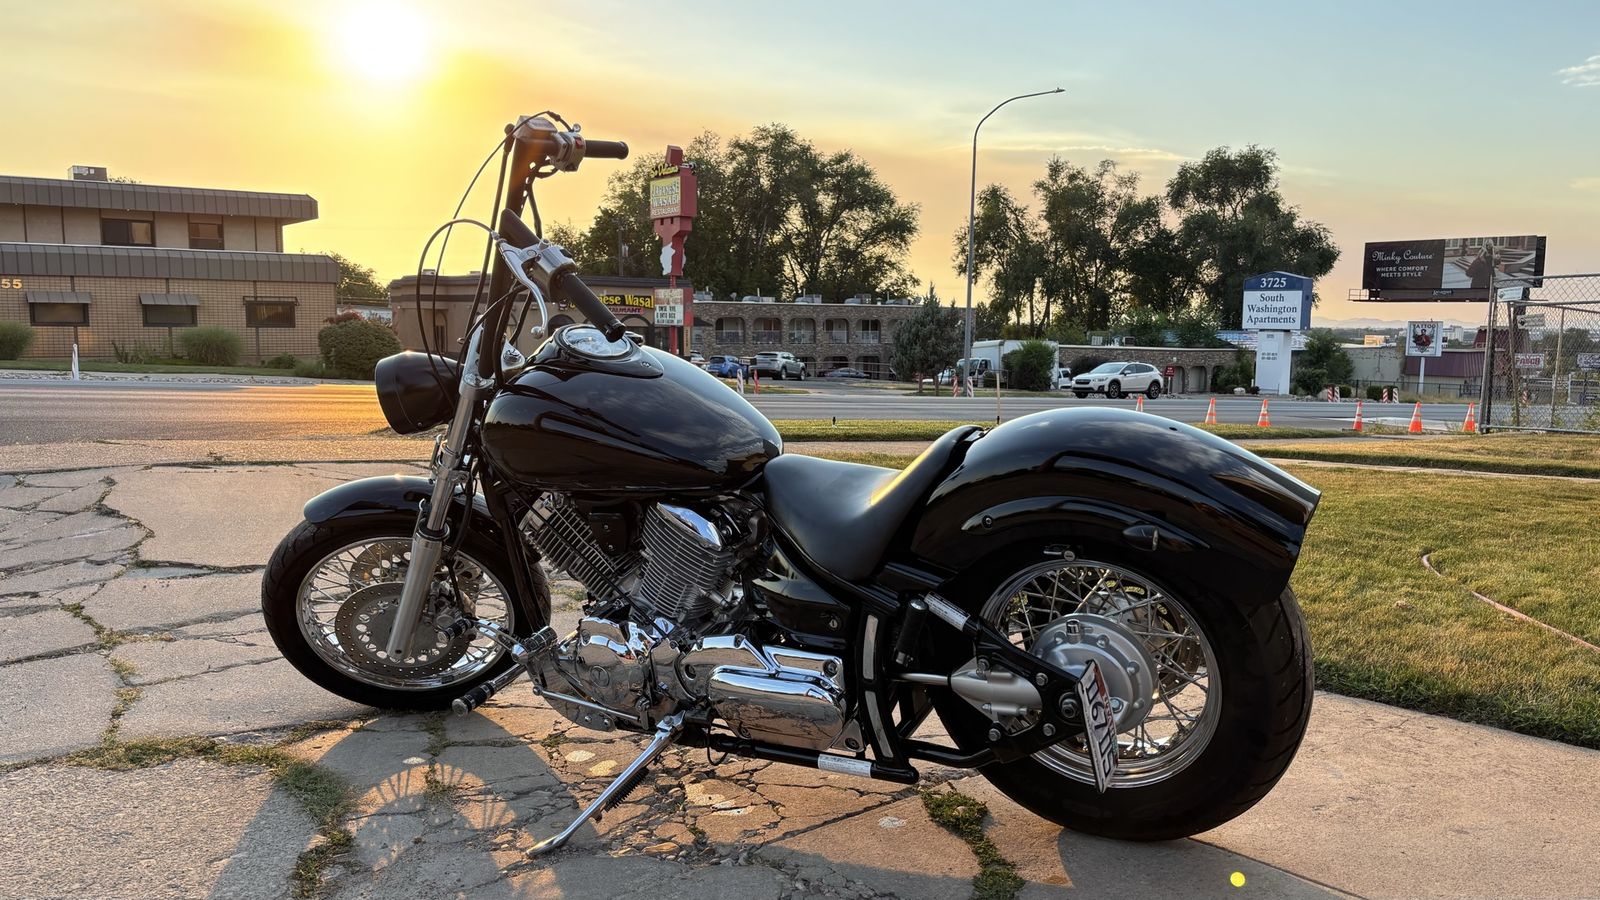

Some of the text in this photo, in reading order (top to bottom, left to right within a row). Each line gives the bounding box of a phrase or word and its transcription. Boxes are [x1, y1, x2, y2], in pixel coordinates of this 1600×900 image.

[1372, 250, 1402, 264] Minky
[1260, 277, 1287, 288] 3725
[1260, 293, 1285, 302] South
[1247, 304, 1297, 315] Washington
[1246, 315, 1296, 325] Apartments
